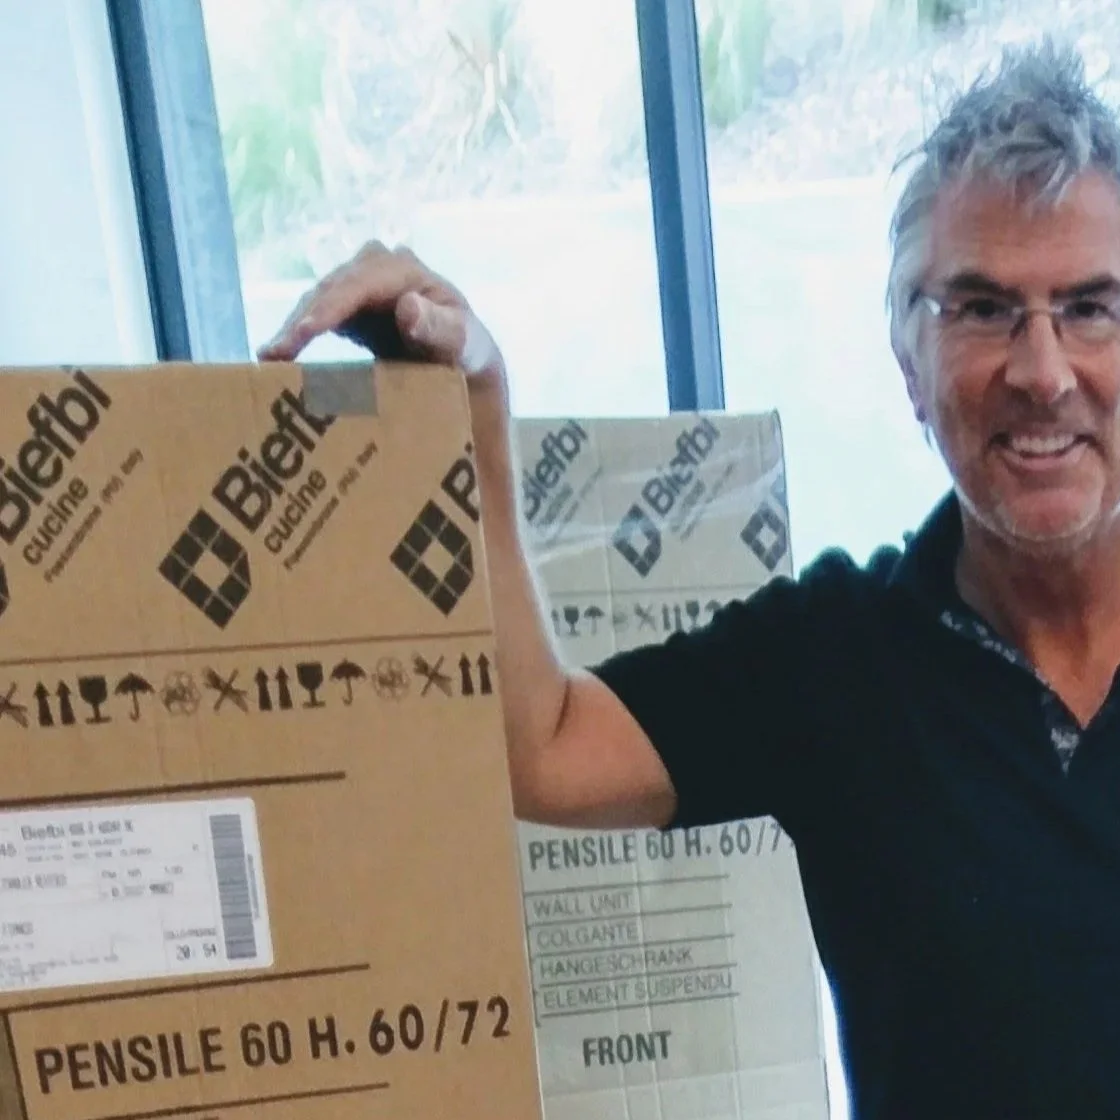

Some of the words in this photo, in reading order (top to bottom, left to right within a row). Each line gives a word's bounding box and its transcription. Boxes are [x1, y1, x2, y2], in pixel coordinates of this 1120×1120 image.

[23, 476, 88, 565] cucine
[263, 469, 327, 554] cucine
[528, 833, 637, 870] PENSILE
[645, 830, 674, 860] 60
[719, 822, 793, 857] 60/7
[533, 897, 587, 918] WALL
[590, 892, 633, 910] UNIT
[536, 924, 639, 949] COLGANTE
[540, 949, 695, 979] HANGESCHRANK
[543, 983, 629, 1009] ELEMENT
[634, 973, 733, 999] SUSPENDU
[35, 1026, 227, 1094] PENSILE
[241, 1022, 292, 1067] 60
[309, 1015, 356, 1060] H.
[369, 995, 511, 1055] 60/72
[582, 1031, 672, 1068] FRONT
